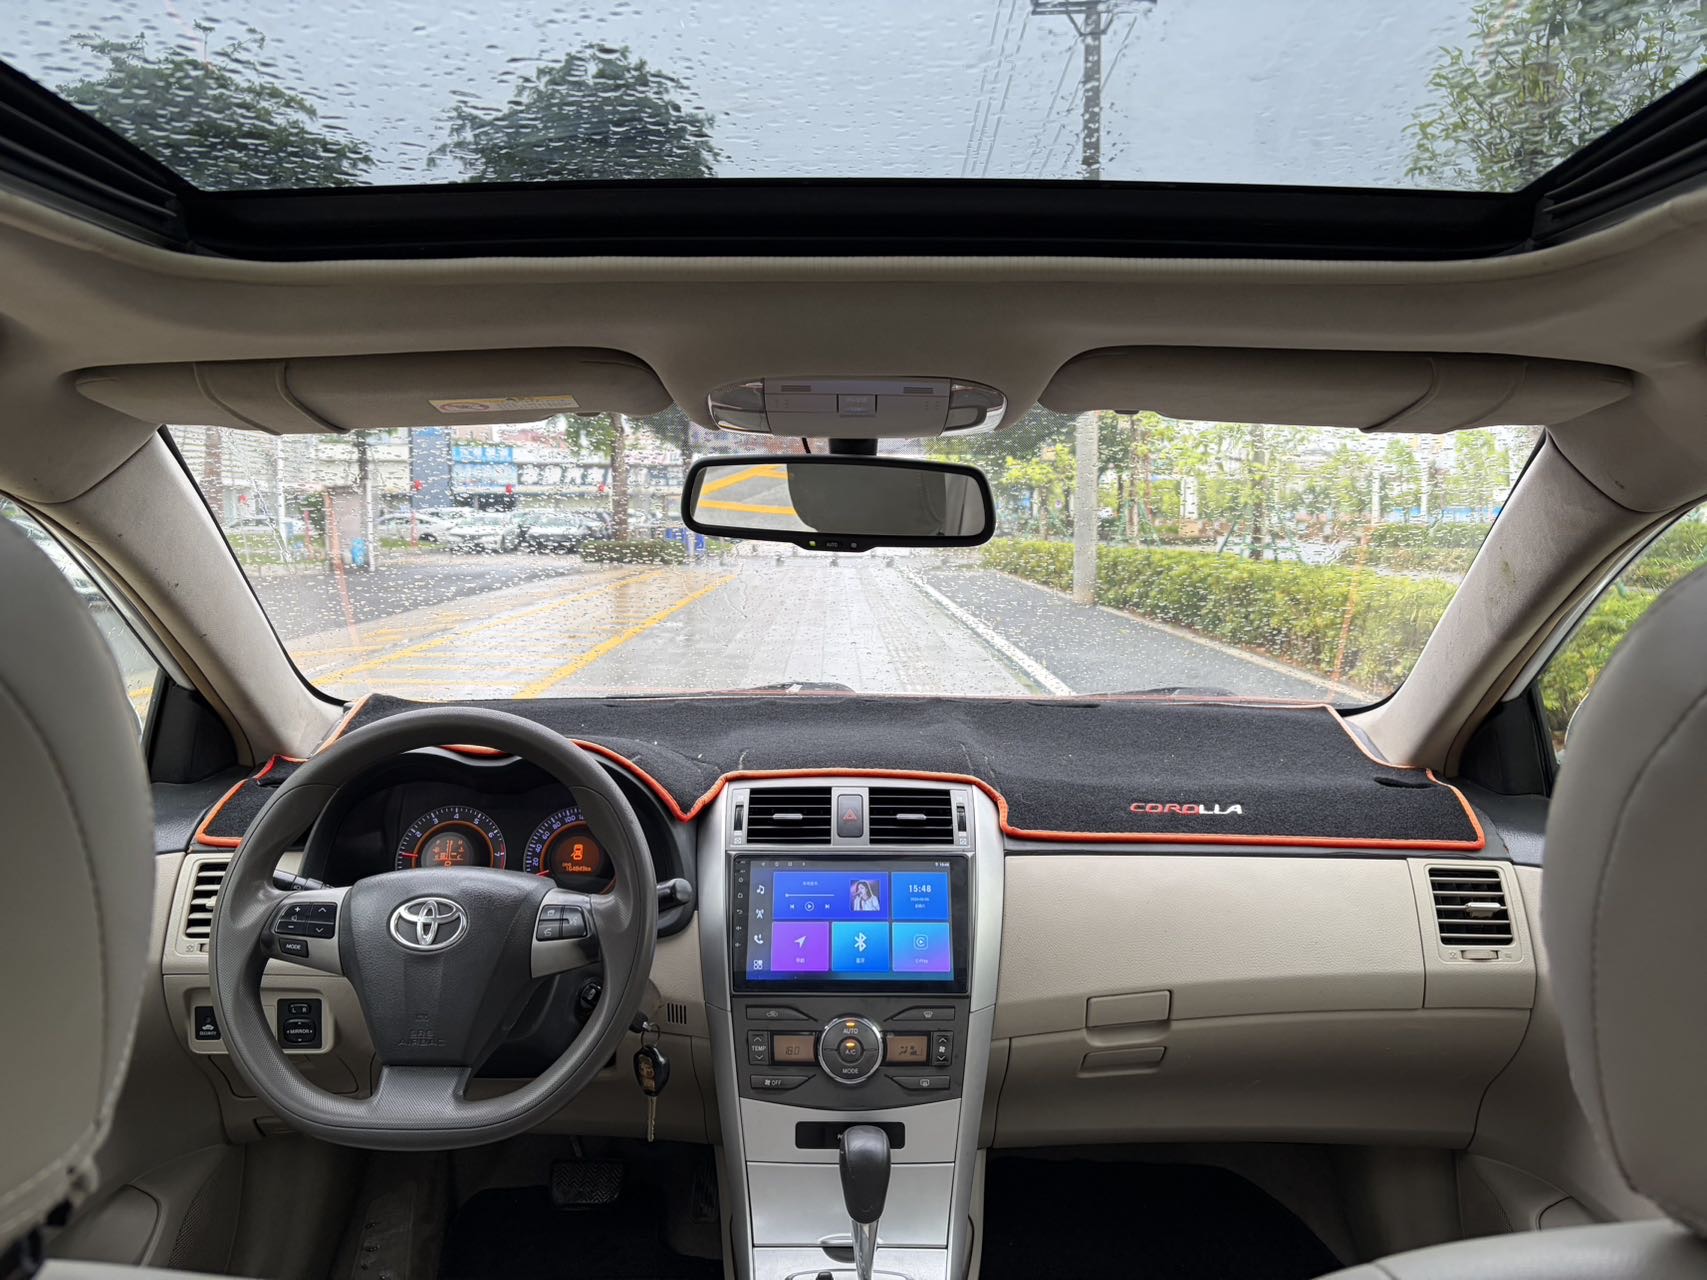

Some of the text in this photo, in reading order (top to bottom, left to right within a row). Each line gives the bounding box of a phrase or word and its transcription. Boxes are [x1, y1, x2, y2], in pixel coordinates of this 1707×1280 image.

[1129, 802, 1243, 816] COROLLA
[564, 815, 576, 823] 100
[552, 821, 561, 830] 80
[542, 831, 551, 840] 60
[535, 843, 542, 853] 40
[532, 857, 539, 867] 20
[909, 884, 932, 893] 15:48
[285, 943, 301, 951] MODE
